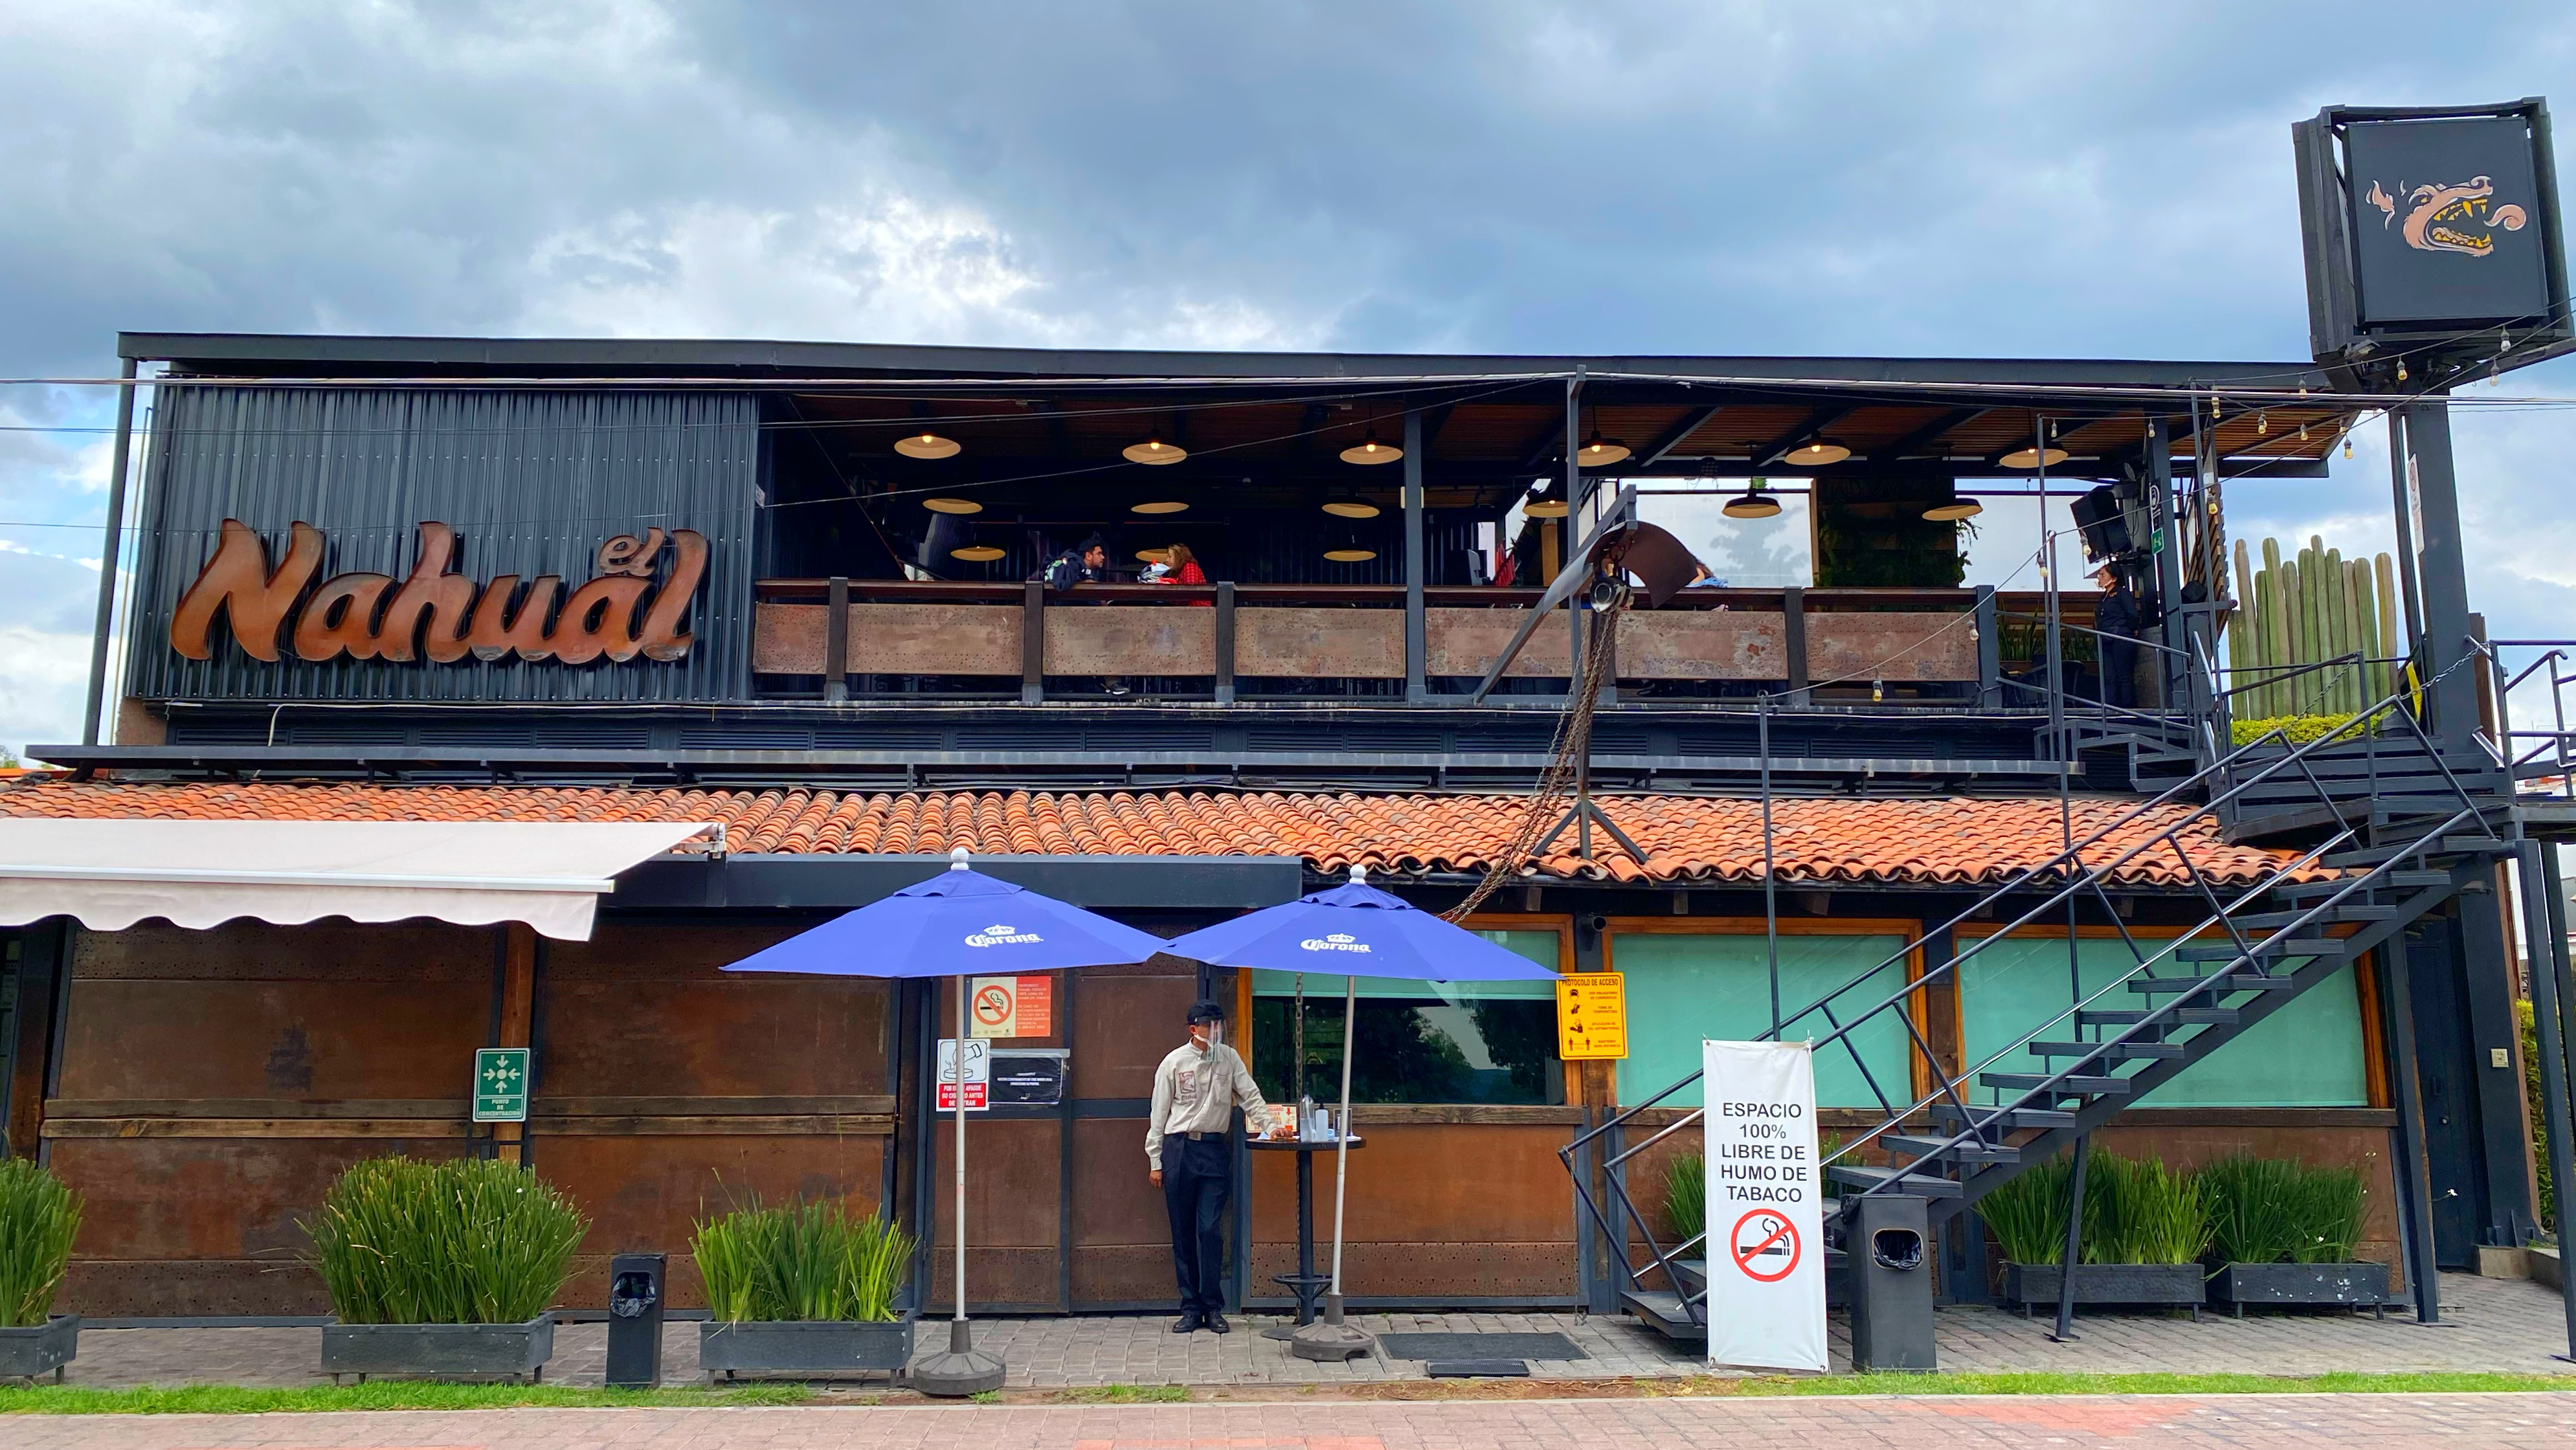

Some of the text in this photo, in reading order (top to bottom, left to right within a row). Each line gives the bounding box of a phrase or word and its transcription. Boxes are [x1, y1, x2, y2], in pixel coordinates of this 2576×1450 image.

[598, 526, 665, 577] el
[170, 518, 708, 665] Nahual
[965, 933, 1044, 948] Corona
[1300, 939, 1372, 953] Corona
[1562, 978, 1590, 987] PROTOCOLO
[1723, 1102, 1802, 1118] ESPACIO
[1739, 1123, 1787, 1139] 100%
[1721, 1143, 1806, 1160] LIBRE DE
[1721, 1164, 1808, 1181] HUMO DE
[1725, 1185, 1802, 1203] TABACO
